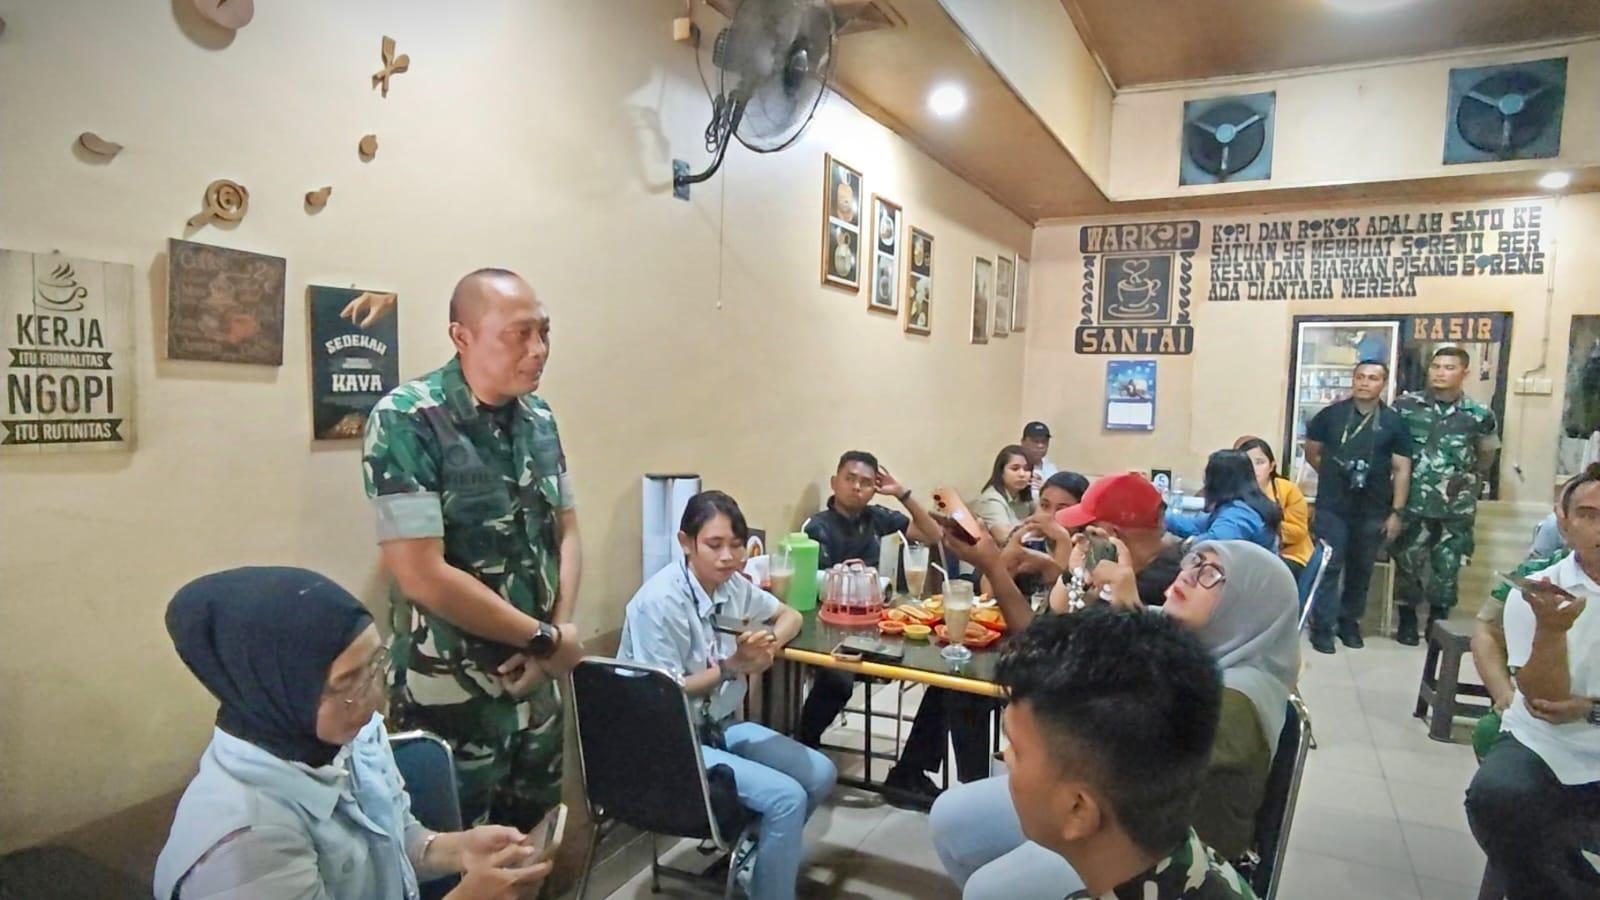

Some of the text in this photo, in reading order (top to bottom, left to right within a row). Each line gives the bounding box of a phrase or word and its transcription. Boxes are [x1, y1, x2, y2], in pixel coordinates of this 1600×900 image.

[1212, 206, 1542, 243] KOPI DAN ROKOK ADALAH SATU KE
[1210, 242, 1277, 262] SATUAN
[1311, 236, 1395, 259] MEMBUAT
[1498, 230, 1541, 253] BER
[1210, 252, 1545, 282] KESAN DAN BIARKAN PISANG GORENG
[1208, 273, 1417, 301] ADA DIANTARA MEREKA
[17, 313, 104, 349] KERJA
[1081, 327, 1186, 353] SANTAI
[1413, 317, 1492, 340] KASIR
[325, 334, 388, 355] SEDEKAH
[19, 351, 104, 368] ITU FORMALITAS
[7, 374, 114, 415] NGOPI
[15, 422, 112, 441] ITU RUTINITAS
